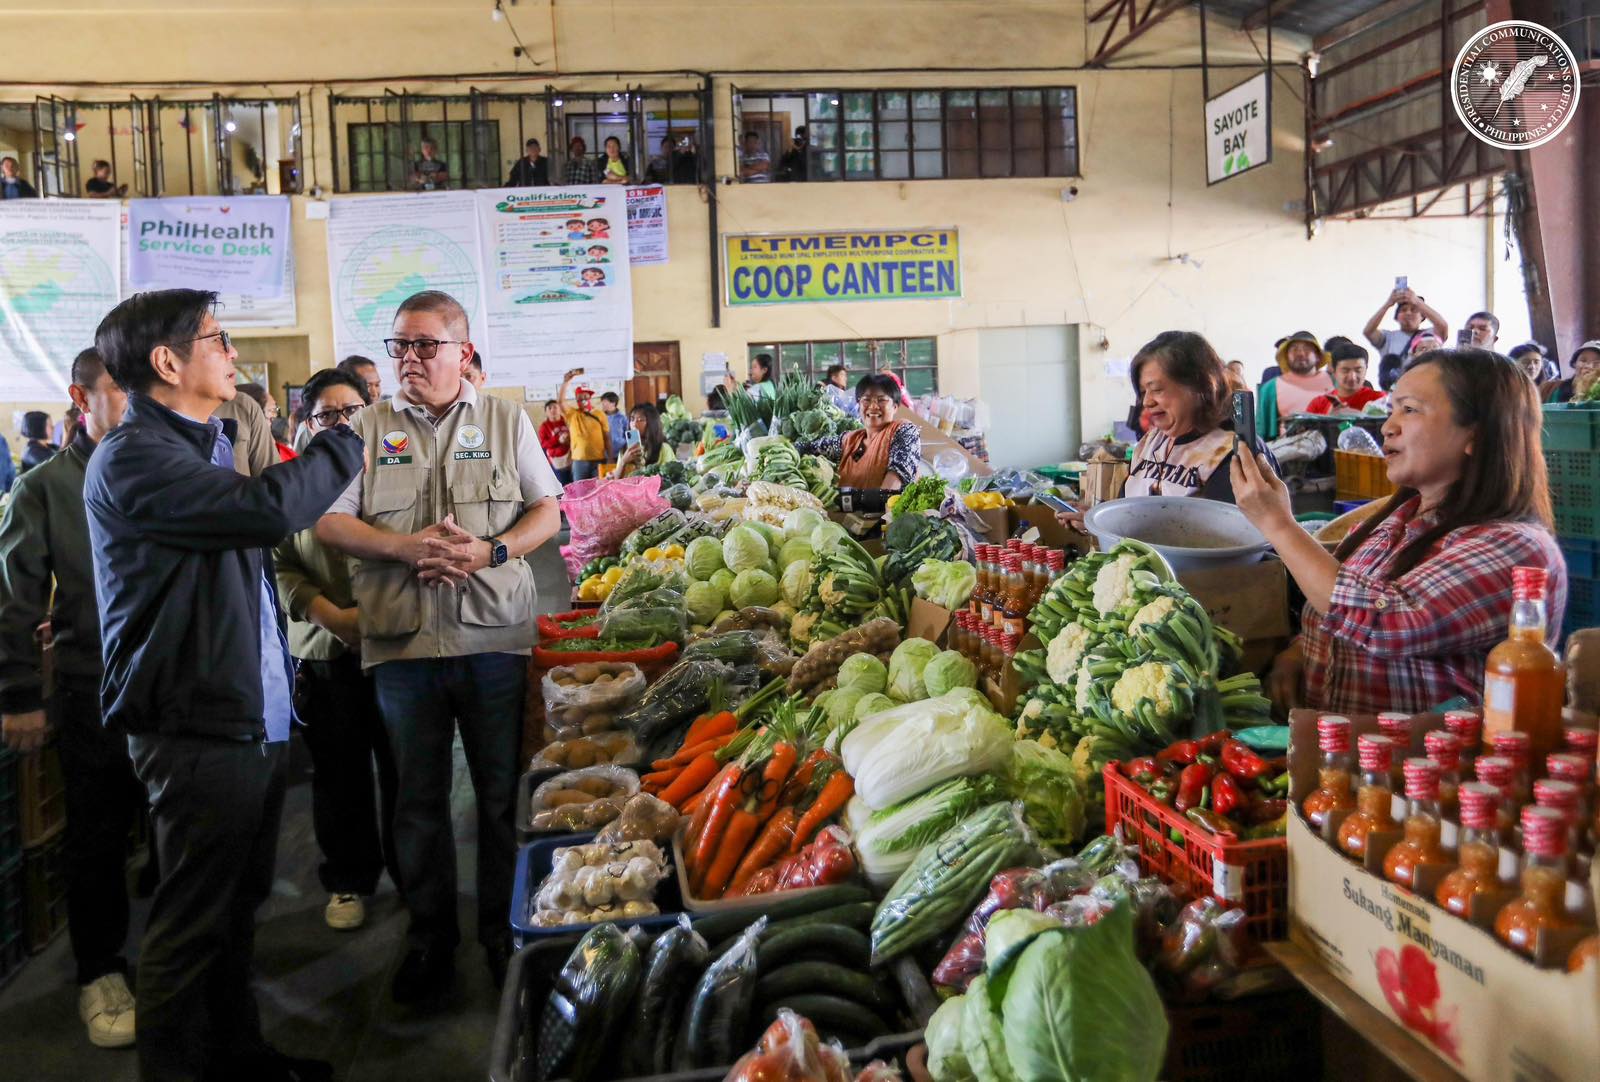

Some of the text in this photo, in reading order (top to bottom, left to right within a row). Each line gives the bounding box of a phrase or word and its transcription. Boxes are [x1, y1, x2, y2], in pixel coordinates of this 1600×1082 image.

[1214, 99, 1258, 136] SAYOTE
[1223, 129, 1247, 156] BAY
[506, 192, 587, 202] Qualifications
[140, 220, 274, 240] PhilHealth
[138, 238, 273, 257] Service Desk
[740, 233, 948, 252] LTMEMPCI
[733, 260, 955, 299] COOP CANTEEN
[472, 451, 490, 459] KIKO
[1381, 884, 1431, 923] Homemade
[1342, 877, 1395, 932] Sukang
[1397, 912, 1486, 986] Manyaman
